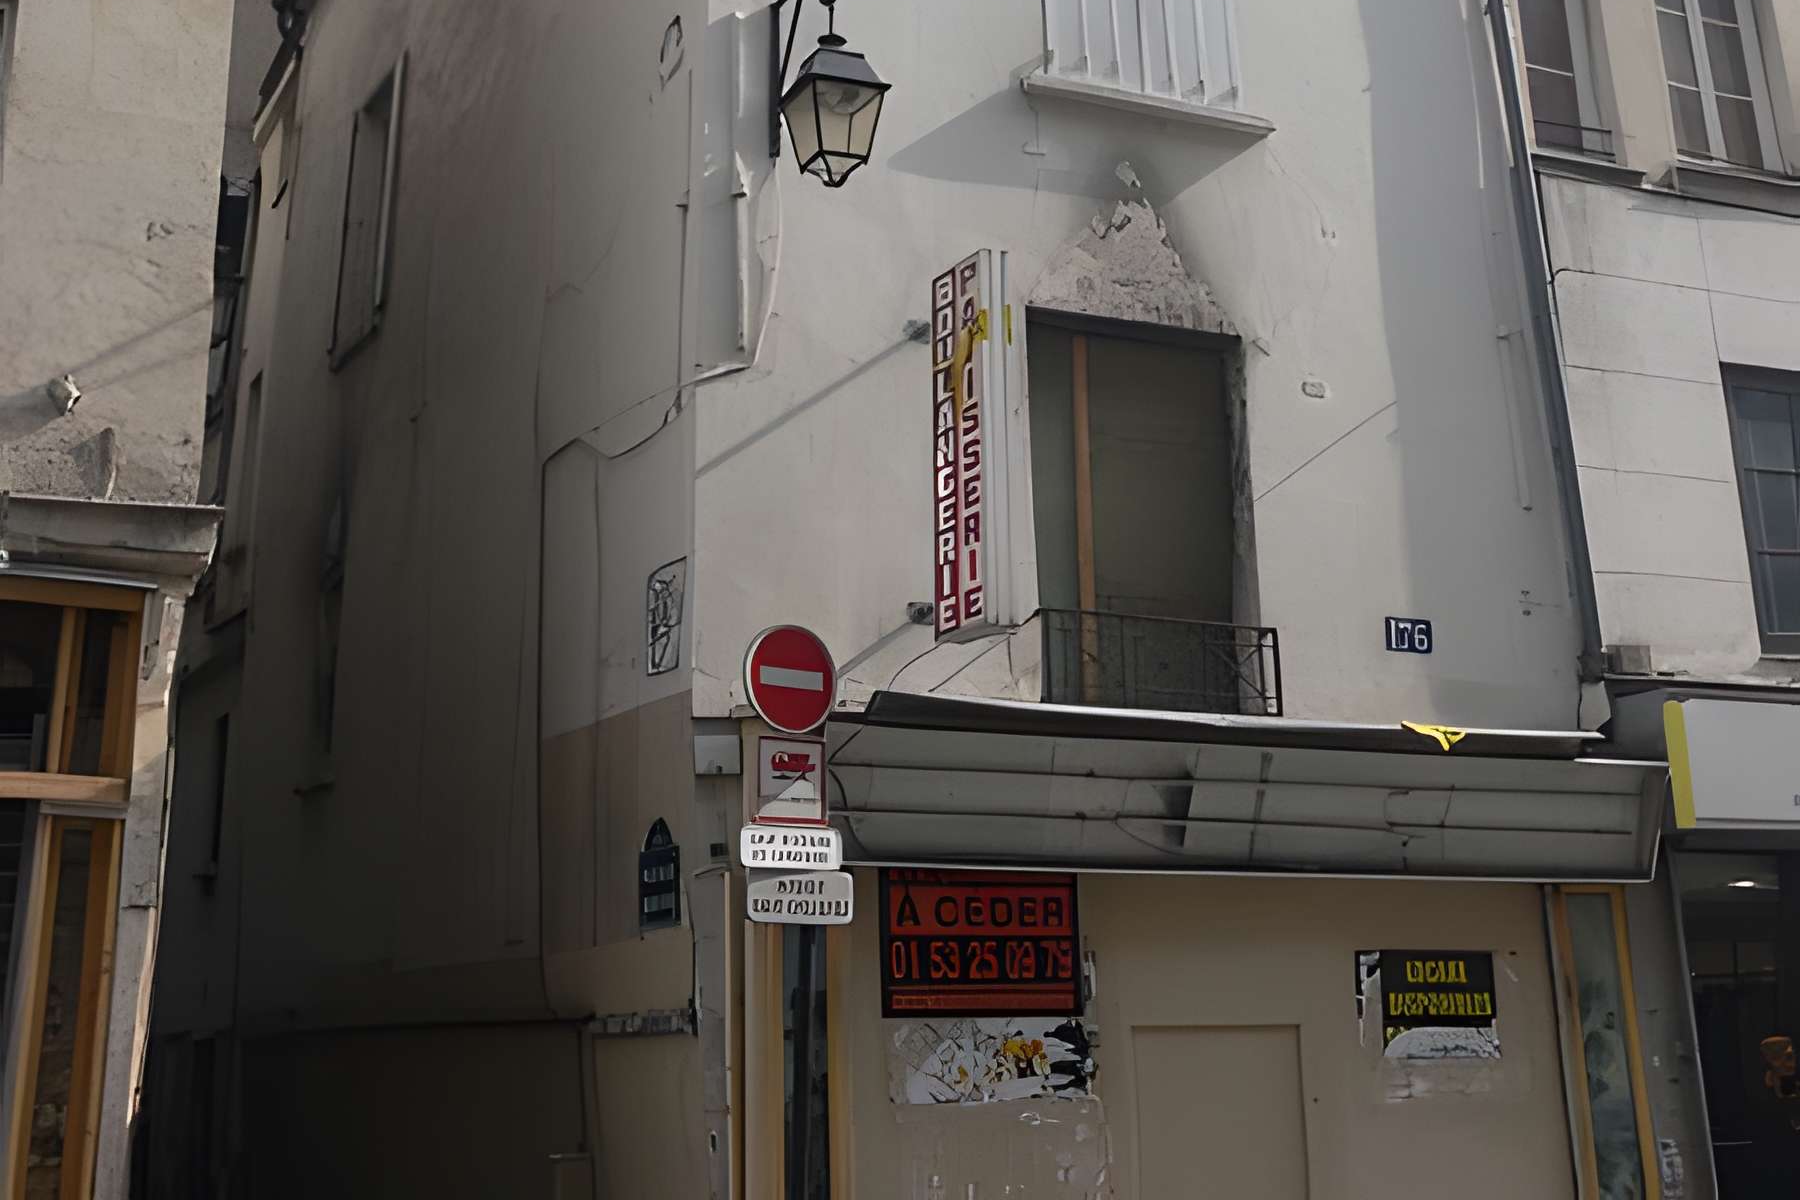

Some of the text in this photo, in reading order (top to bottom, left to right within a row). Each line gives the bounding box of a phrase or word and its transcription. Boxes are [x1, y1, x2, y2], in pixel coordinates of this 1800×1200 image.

[1391, 619, 1428, 651] 176
[892, 940, 920, 980] 01
[930, 940, 962, 980] 53
[967, 940, 999, 980] 25
